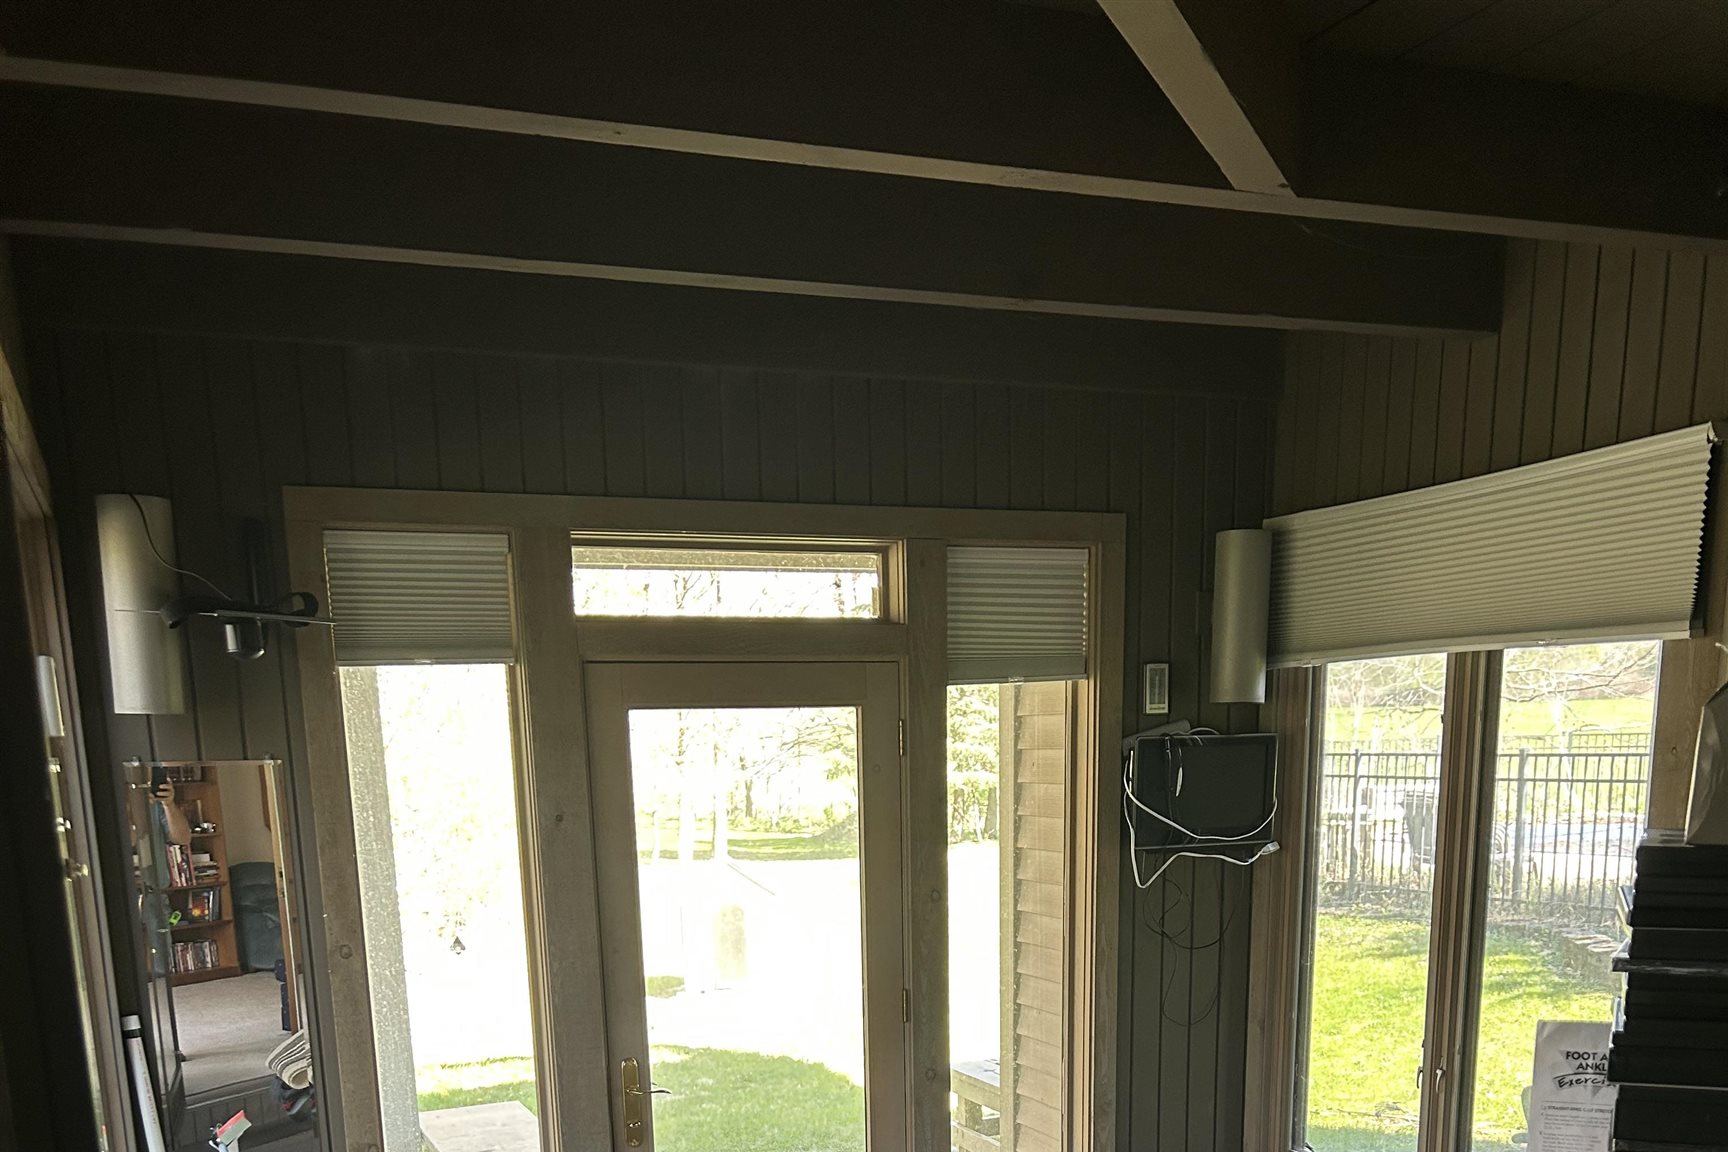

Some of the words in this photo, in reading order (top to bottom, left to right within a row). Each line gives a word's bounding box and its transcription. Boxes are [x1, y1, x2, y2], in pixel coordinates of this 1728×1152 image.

[1565, 1051, 1598, 1060] FOOT
[1576, 1062, 1607, 1071] ANKL
[1558, 1077, 1617, 1088] Exerci
